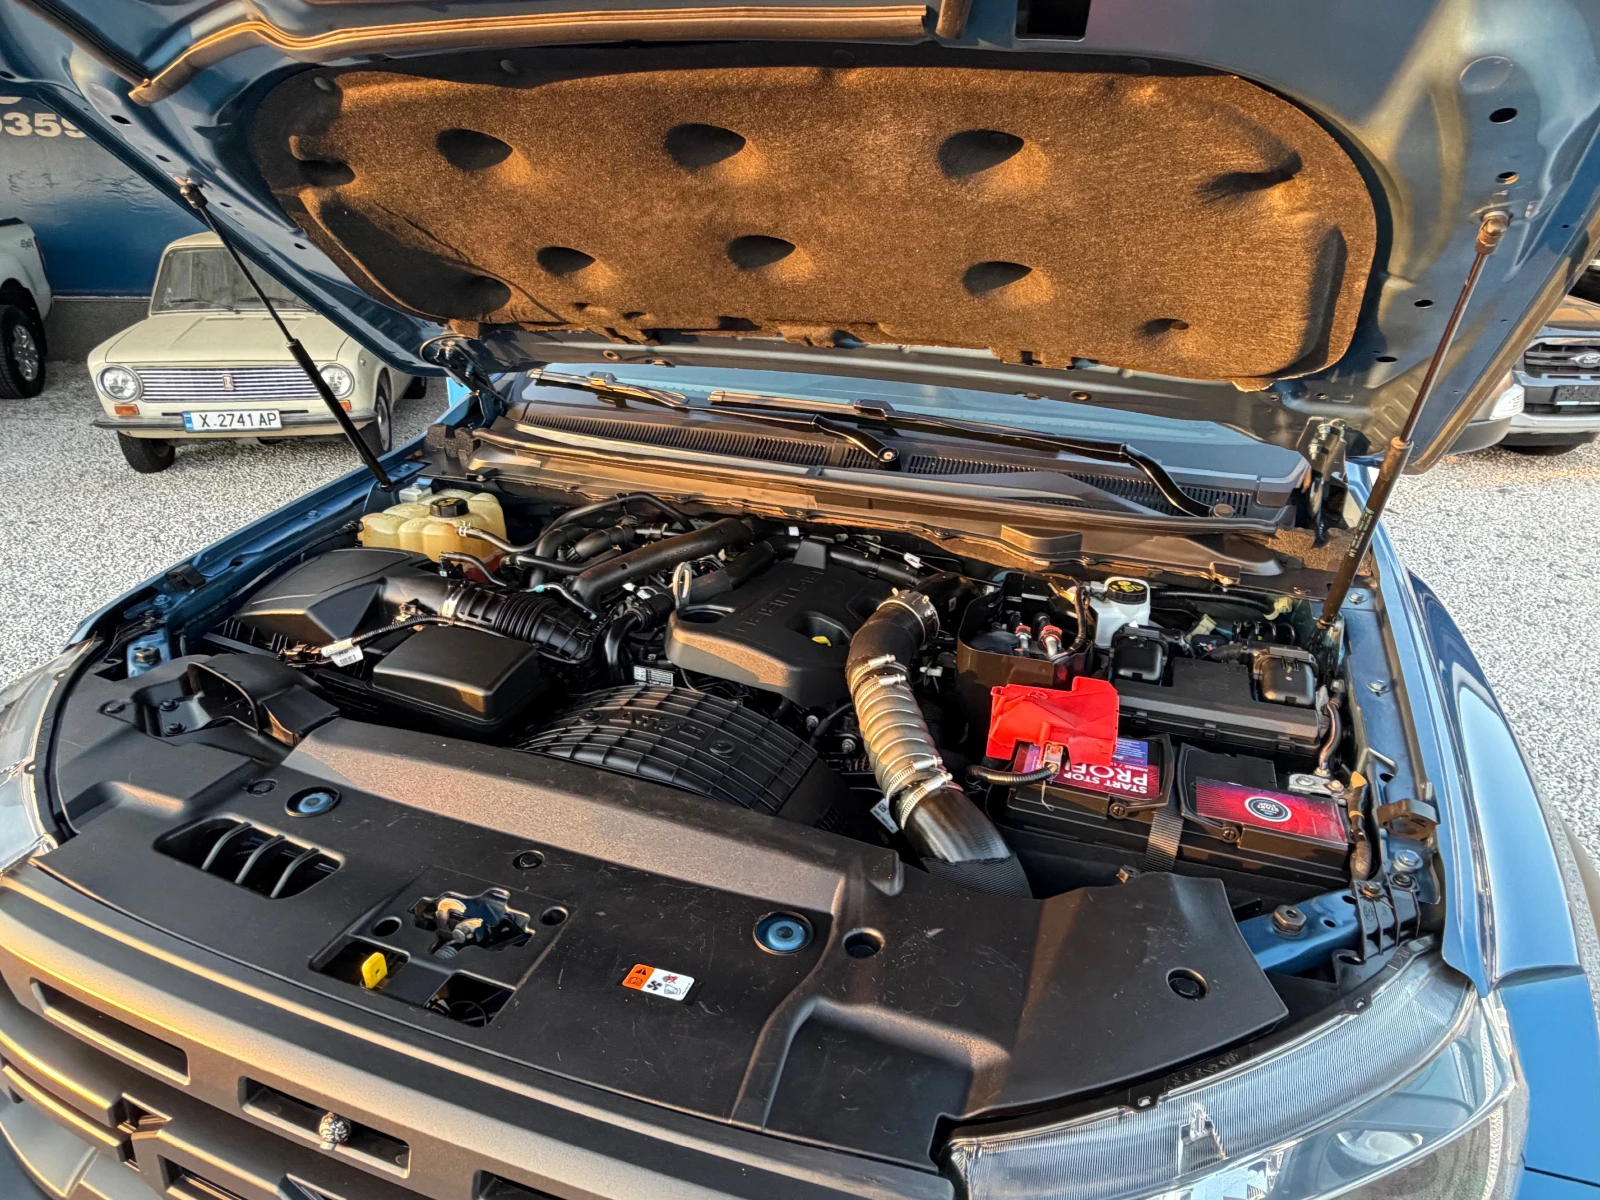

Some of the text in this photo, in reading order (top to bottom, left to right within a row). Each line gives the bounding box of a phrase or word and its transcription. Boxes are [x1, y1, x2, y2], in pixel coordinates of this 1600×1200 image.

[217, 413, 254, 428] 2741
[259, 412, 277, 427] AP
[1063, 771, 1148, 794] START STOP
